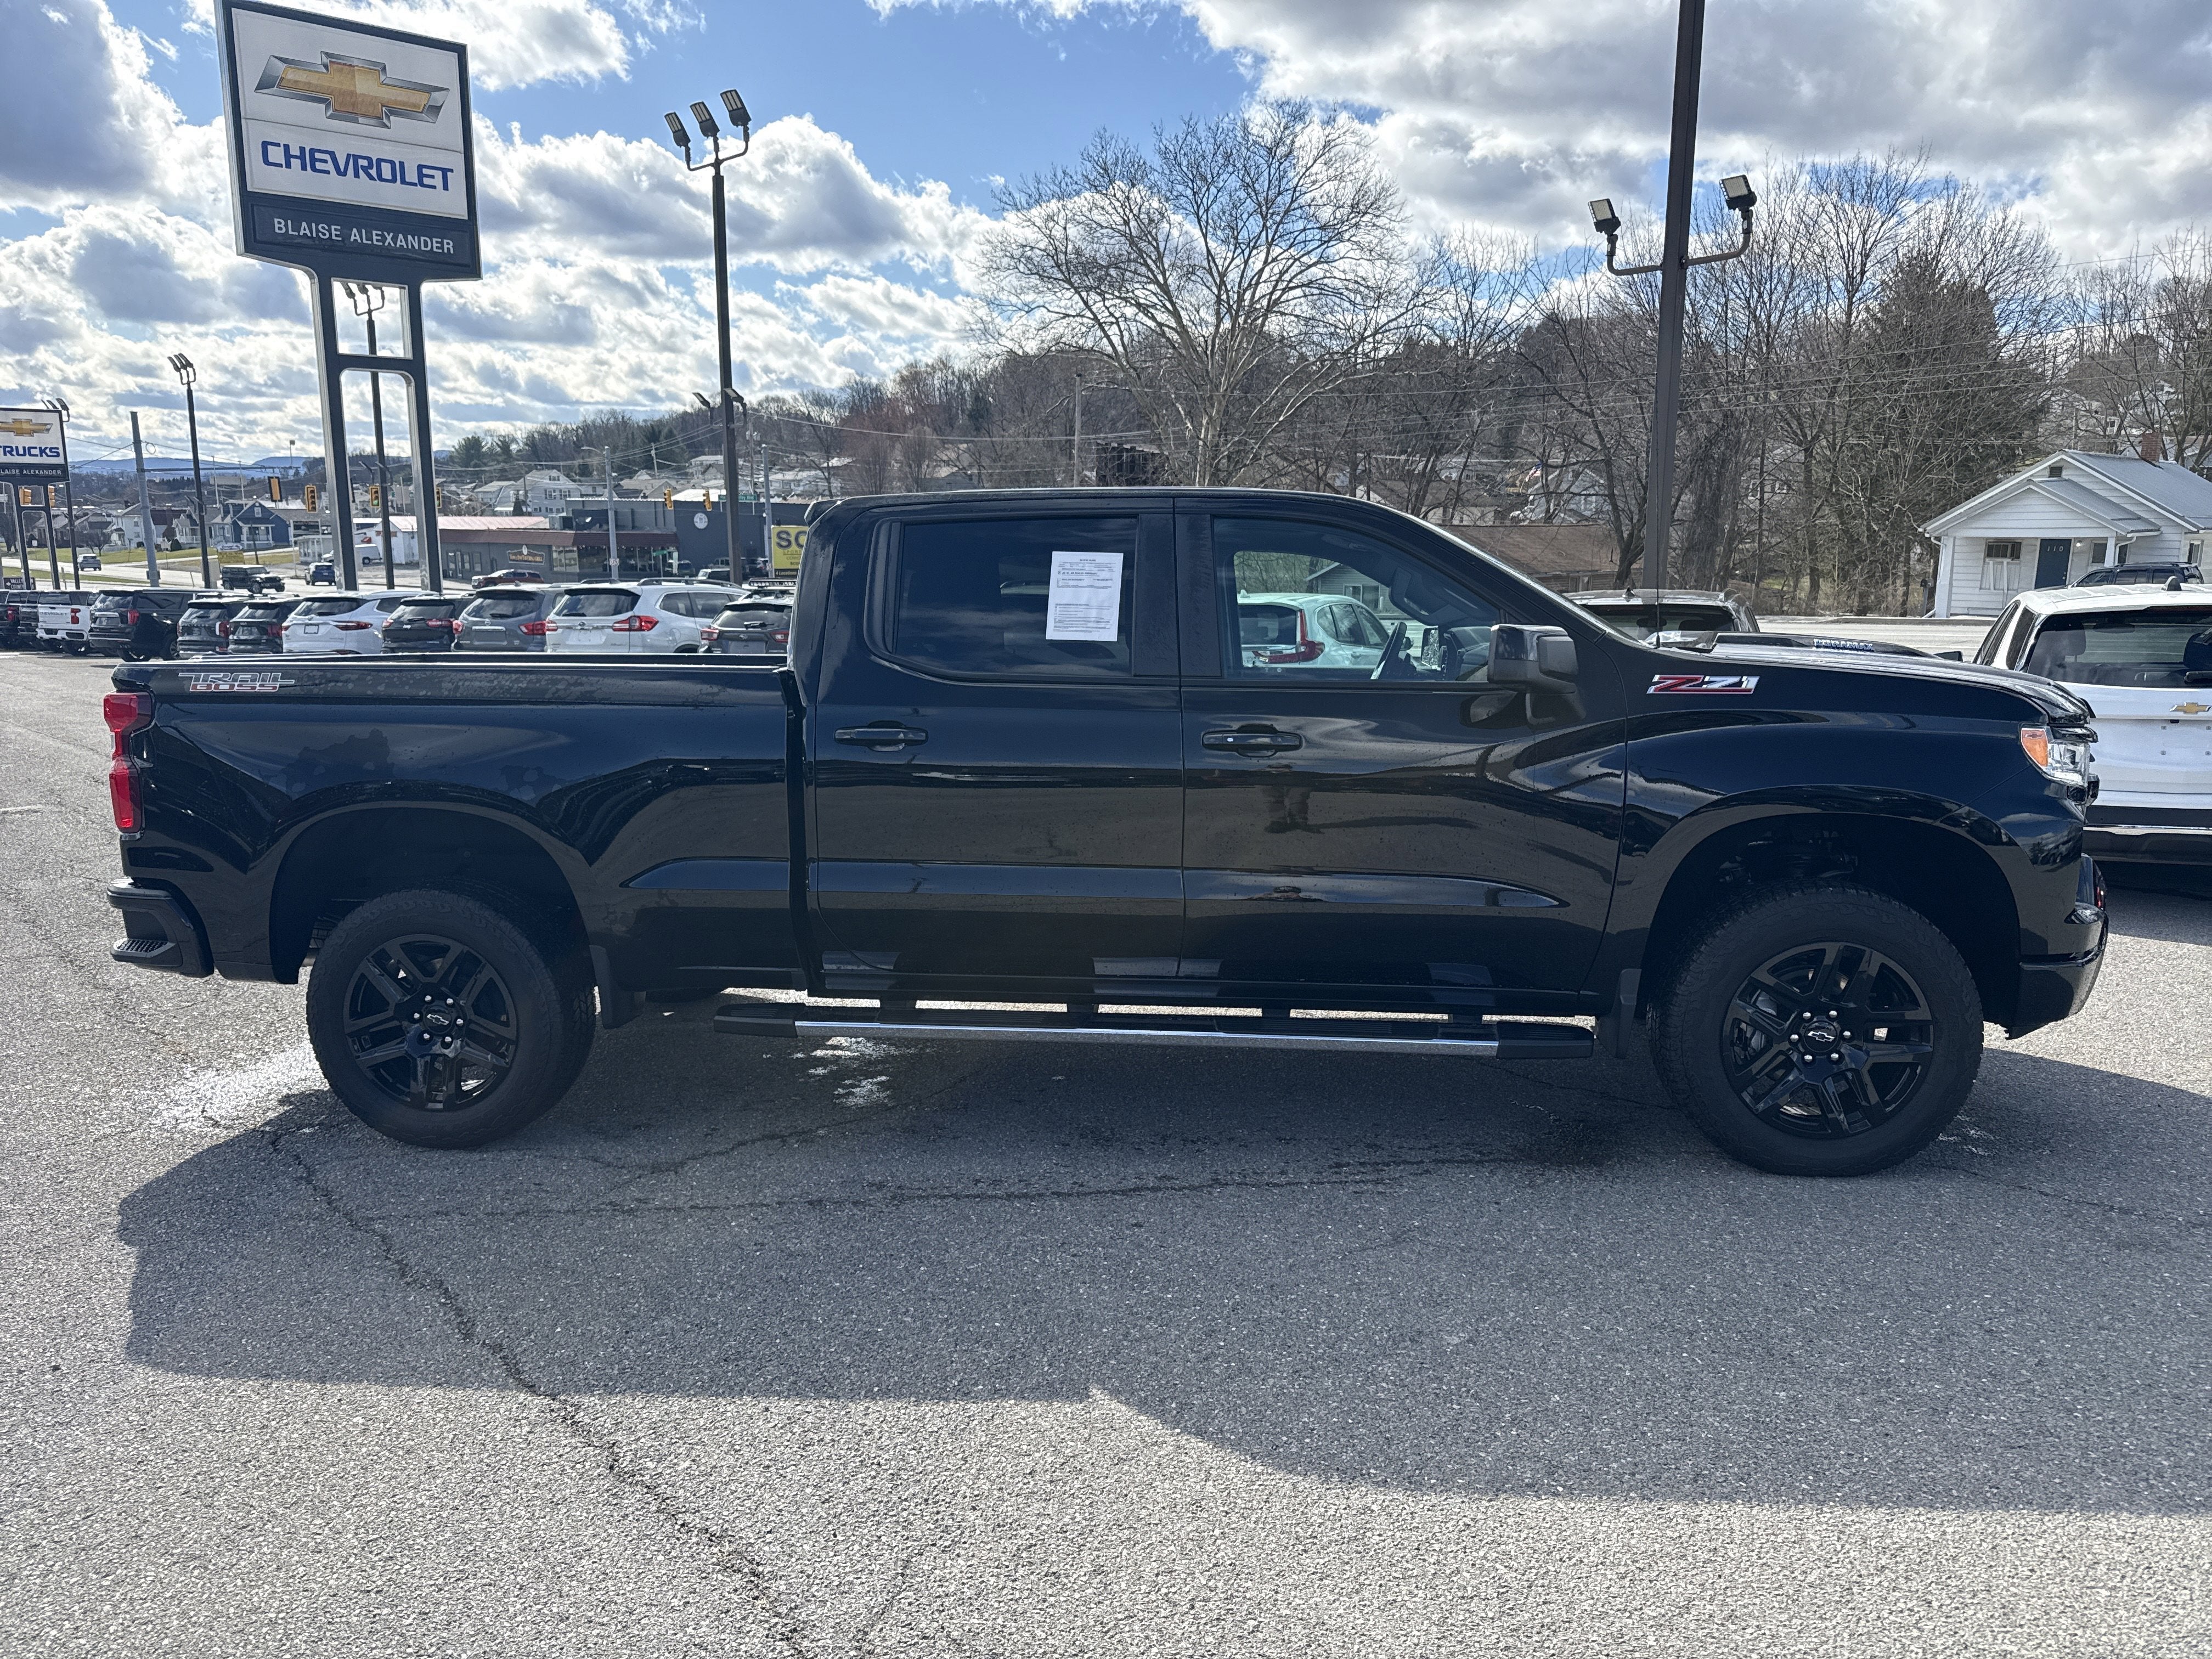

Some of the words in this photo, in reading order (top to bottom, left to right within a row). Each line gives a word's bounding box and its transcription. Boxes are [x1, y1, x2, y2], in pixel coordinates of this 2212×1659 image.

[261, 140, 454, 191] CHEVROLET
[274, 218, 342, 241] BLAISE
[350, 228, 454, 254] ALEXANDER
[0, 445, 60, 458] RUCKS
[178, 673, 295, 684] TRAIL
[1646, 674, 1760, 694] Z71
[189, 682, 279, 692] BOSS
